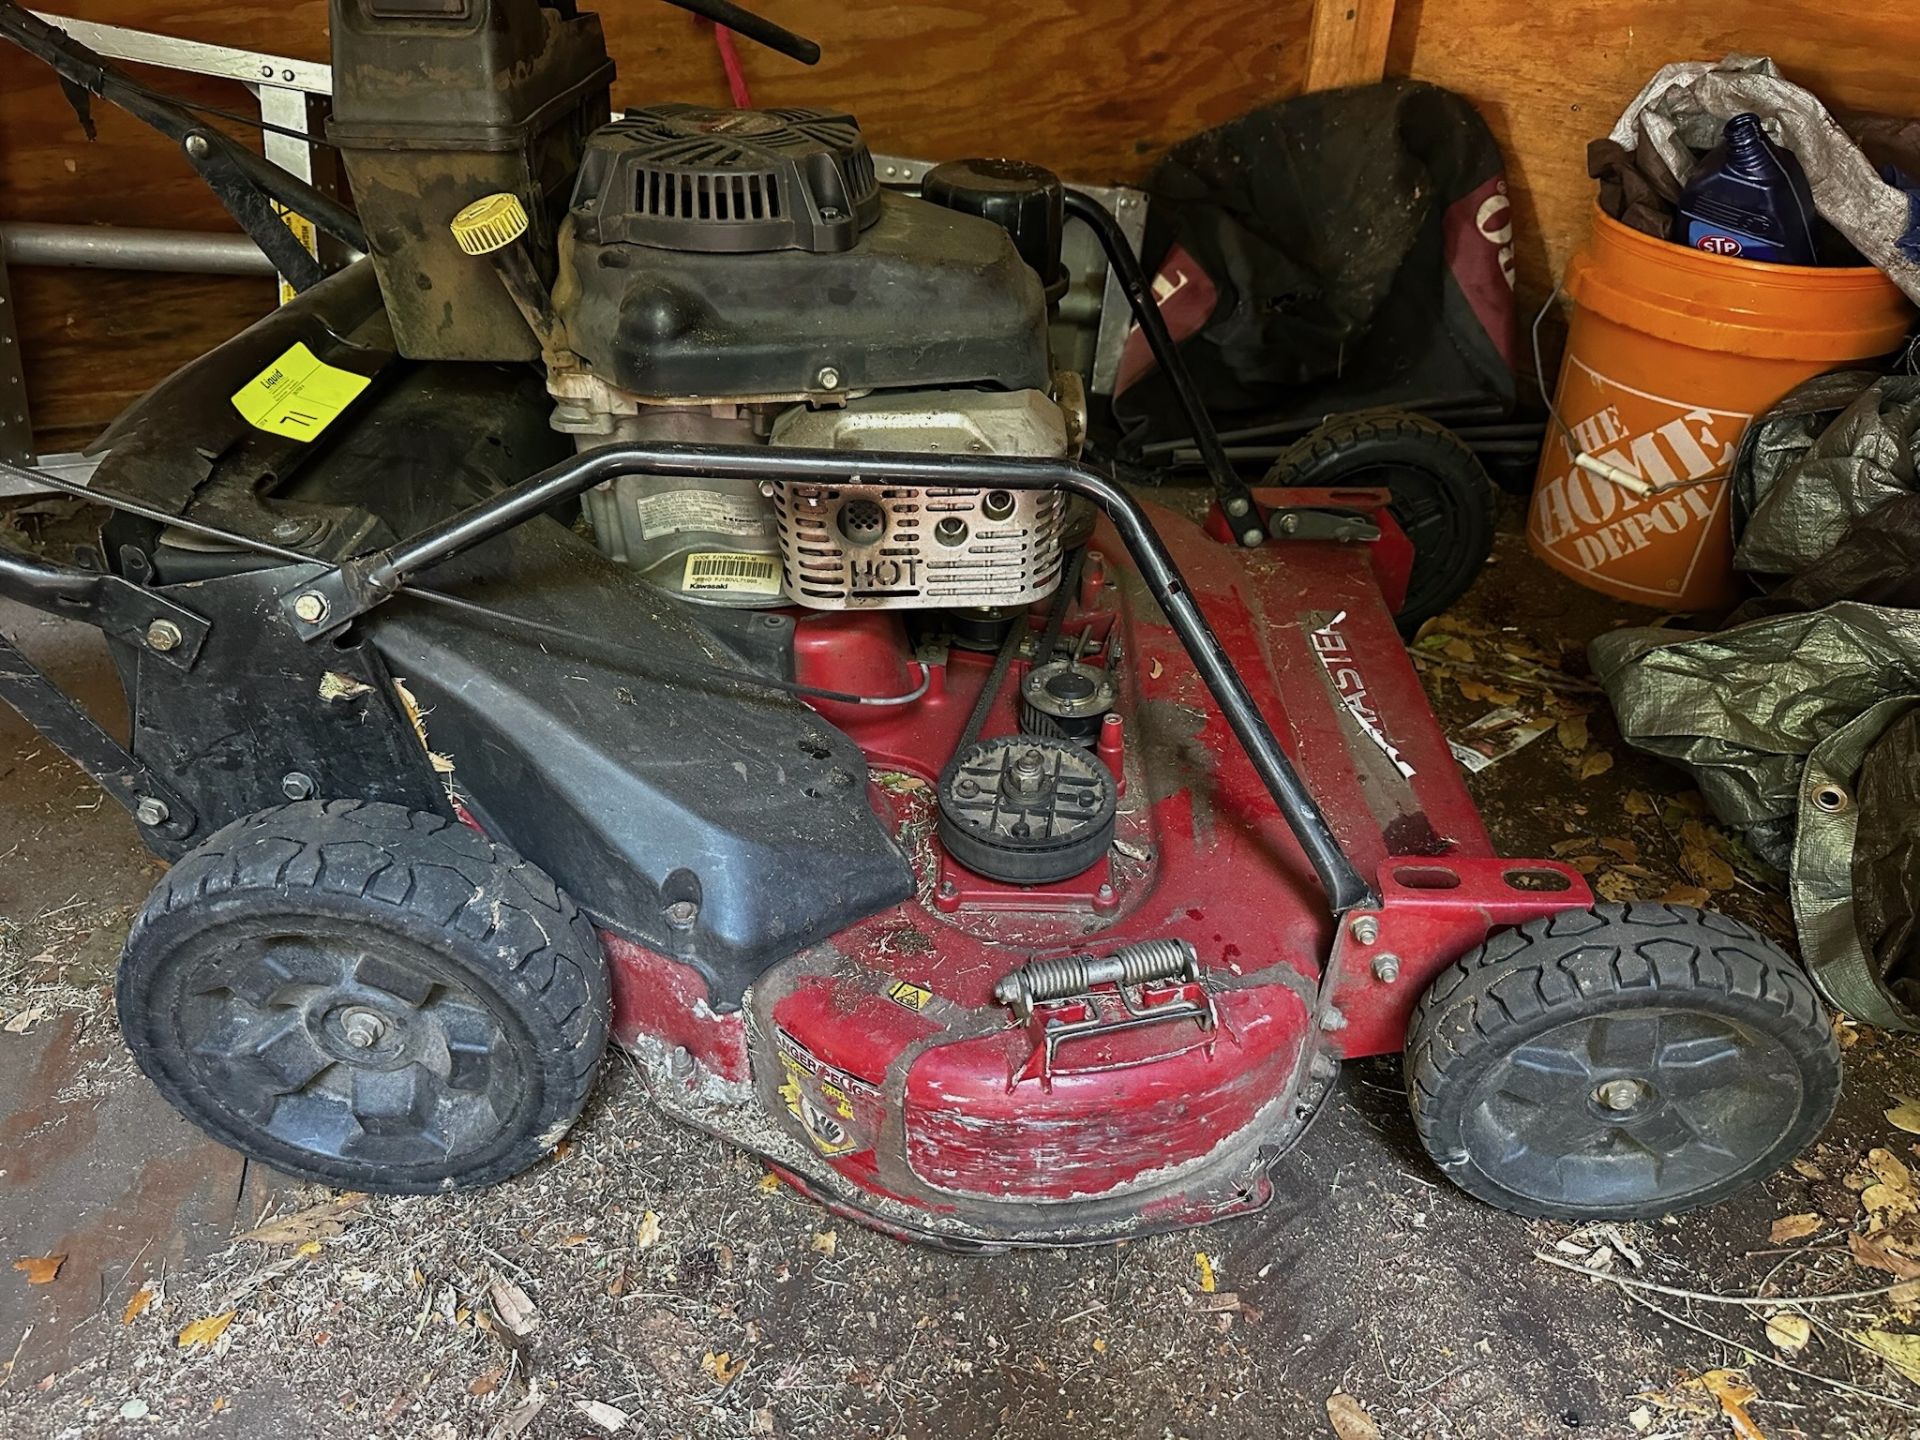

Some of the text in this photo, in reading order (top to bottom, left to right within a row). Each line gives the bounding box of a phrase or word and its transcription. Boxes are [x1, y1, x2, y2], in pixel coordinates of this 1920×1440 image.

[1703, 237, 1737, 254] STP
[259, 368, 284, 390] Liquid
[279, 410, 318, 427] 71
[1560, 404, 1630, 464] THE
[1537, 408, 1738, 546] HOME
[1572, 484, 1713, 571] DEPOT
[850, 558, 923, 588] HOT
